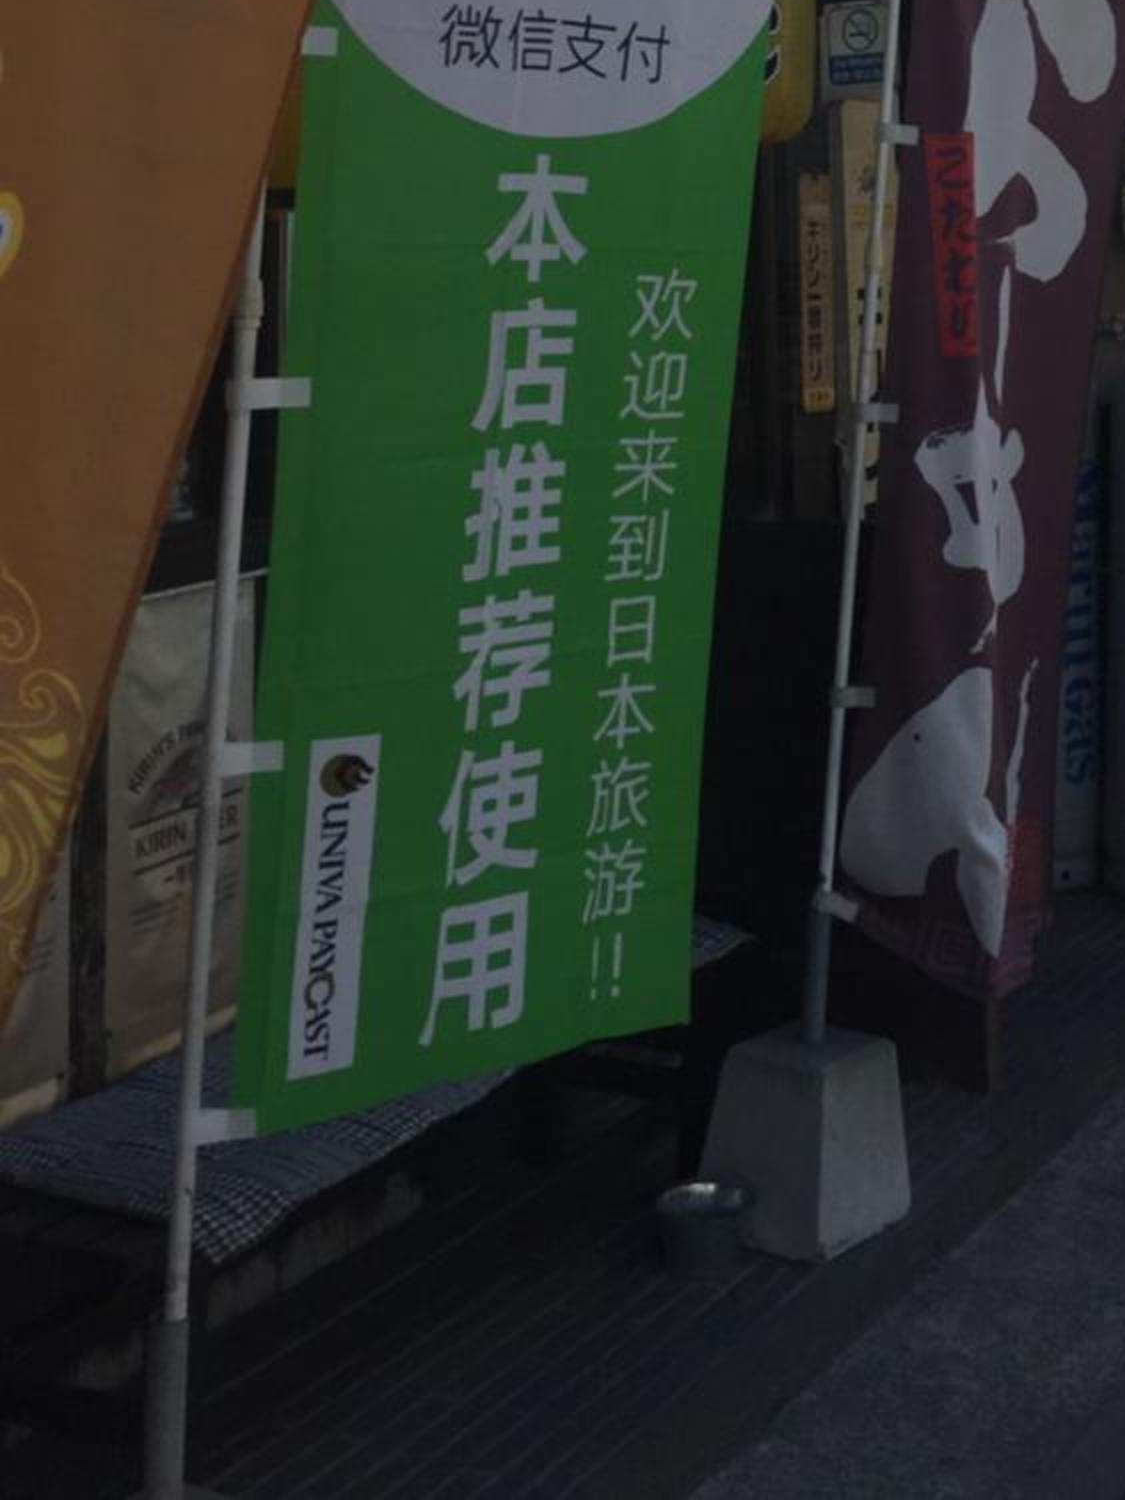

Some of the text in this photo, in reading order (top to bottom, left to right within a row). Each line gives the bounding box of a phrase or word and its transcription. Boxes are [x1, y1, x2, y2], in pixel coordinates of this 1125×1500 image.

[438, 2, 671, 85] 微信支付
[418, 152, 589, 1048] 本店推荐使用
[134, 819, 187, 858] KIRIN
[302, 801, 351, 1063] UNIVA PAYCAST
